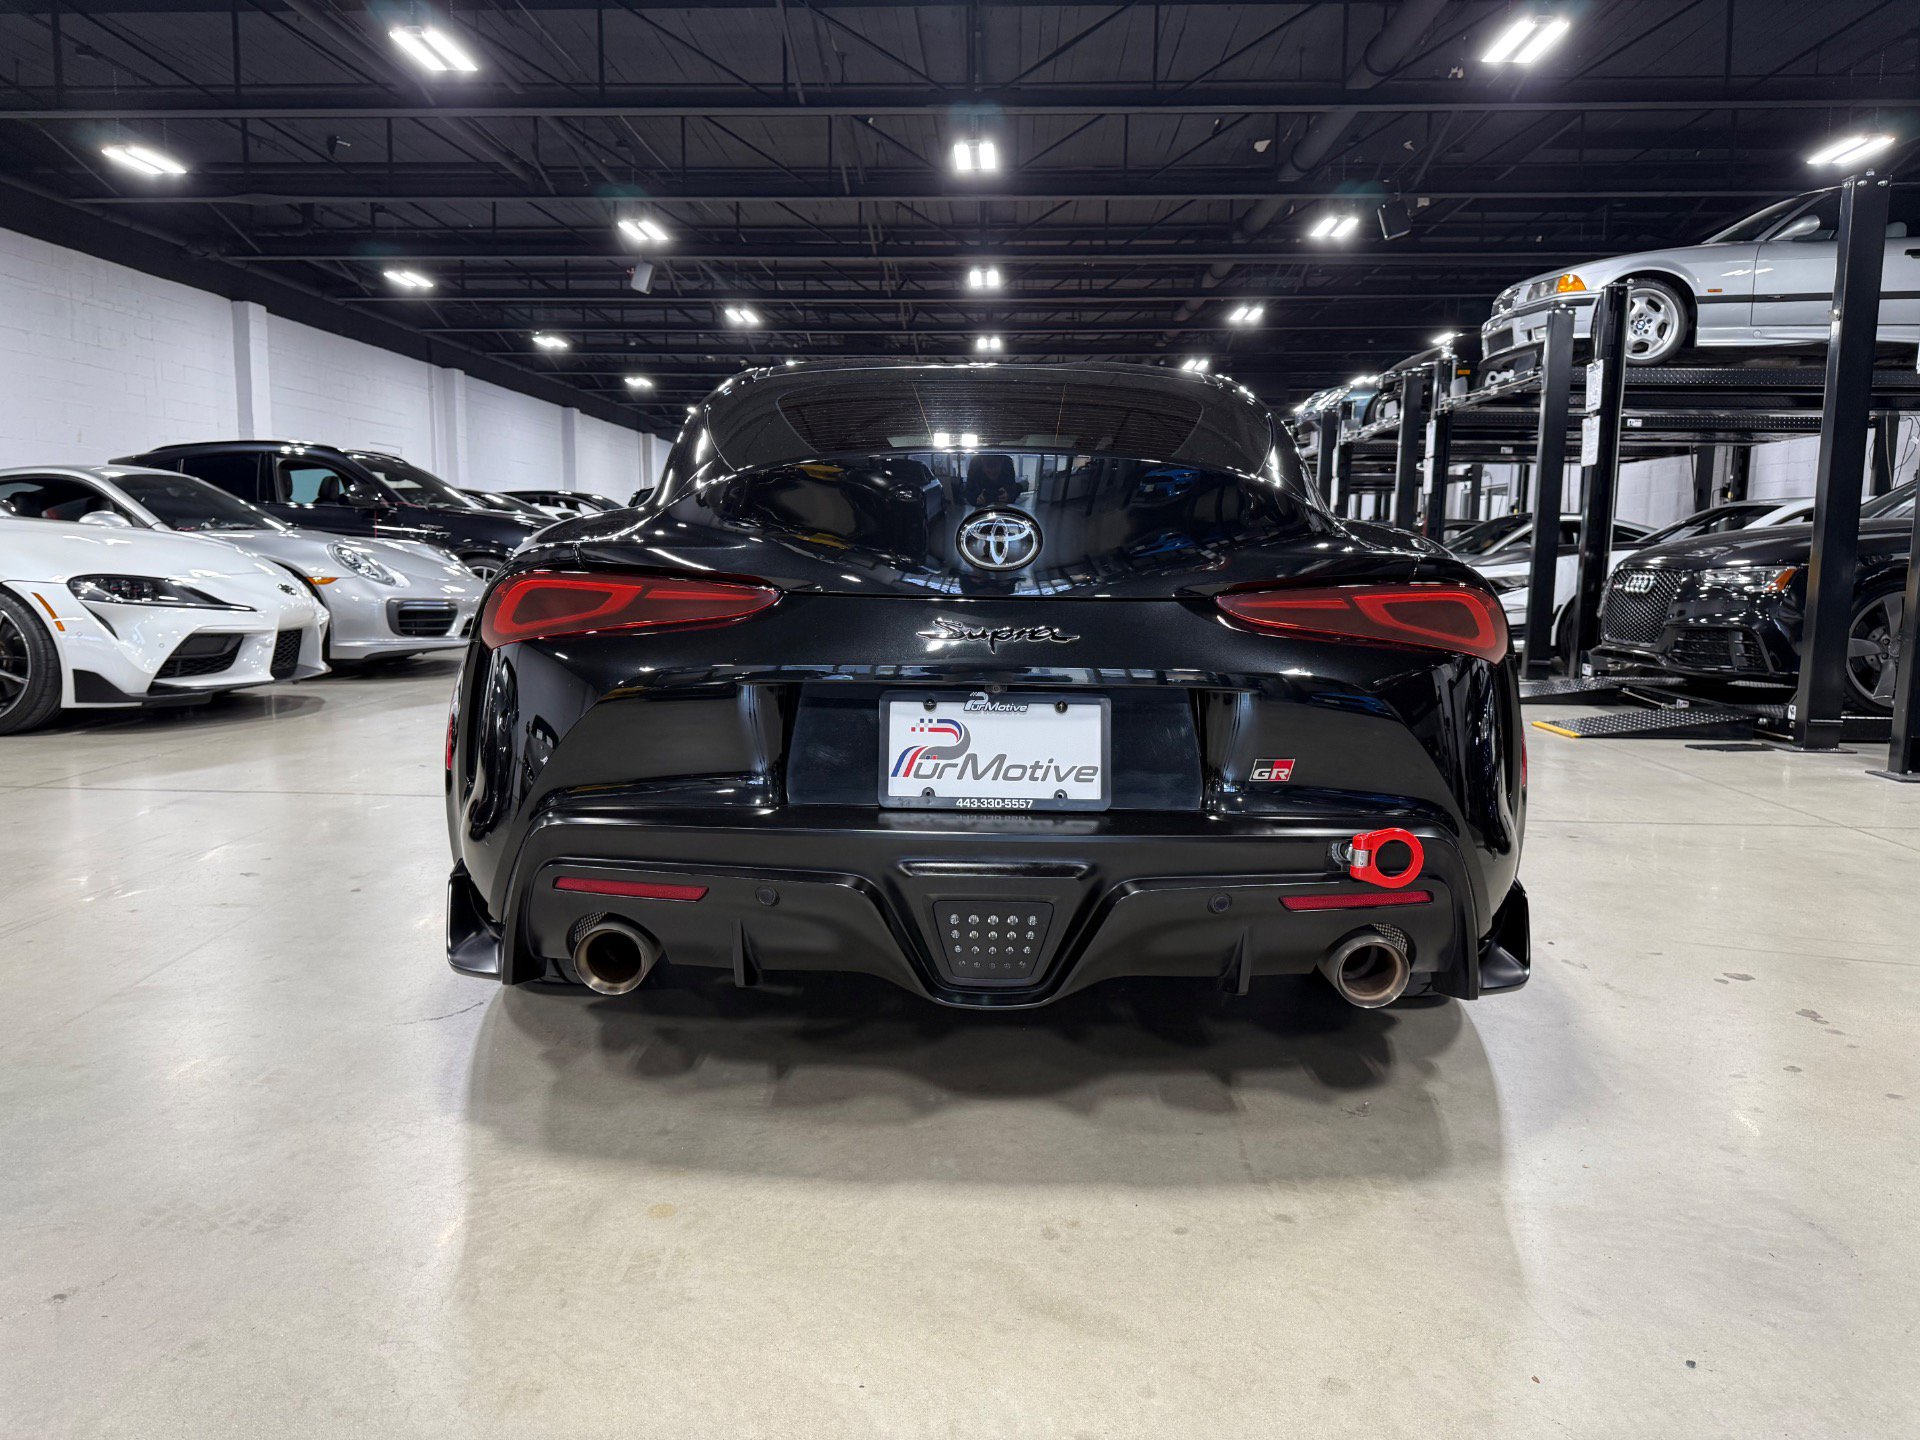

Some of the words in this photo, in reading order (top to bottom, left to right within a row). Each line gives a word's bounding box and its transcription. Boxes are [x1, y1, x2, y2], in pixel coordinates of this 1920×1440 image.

[916, 617, 1080, 654] Supra
[1252, 768, 1290, 780] GR
[956, 798, 1033, 809] 443-330-5557
